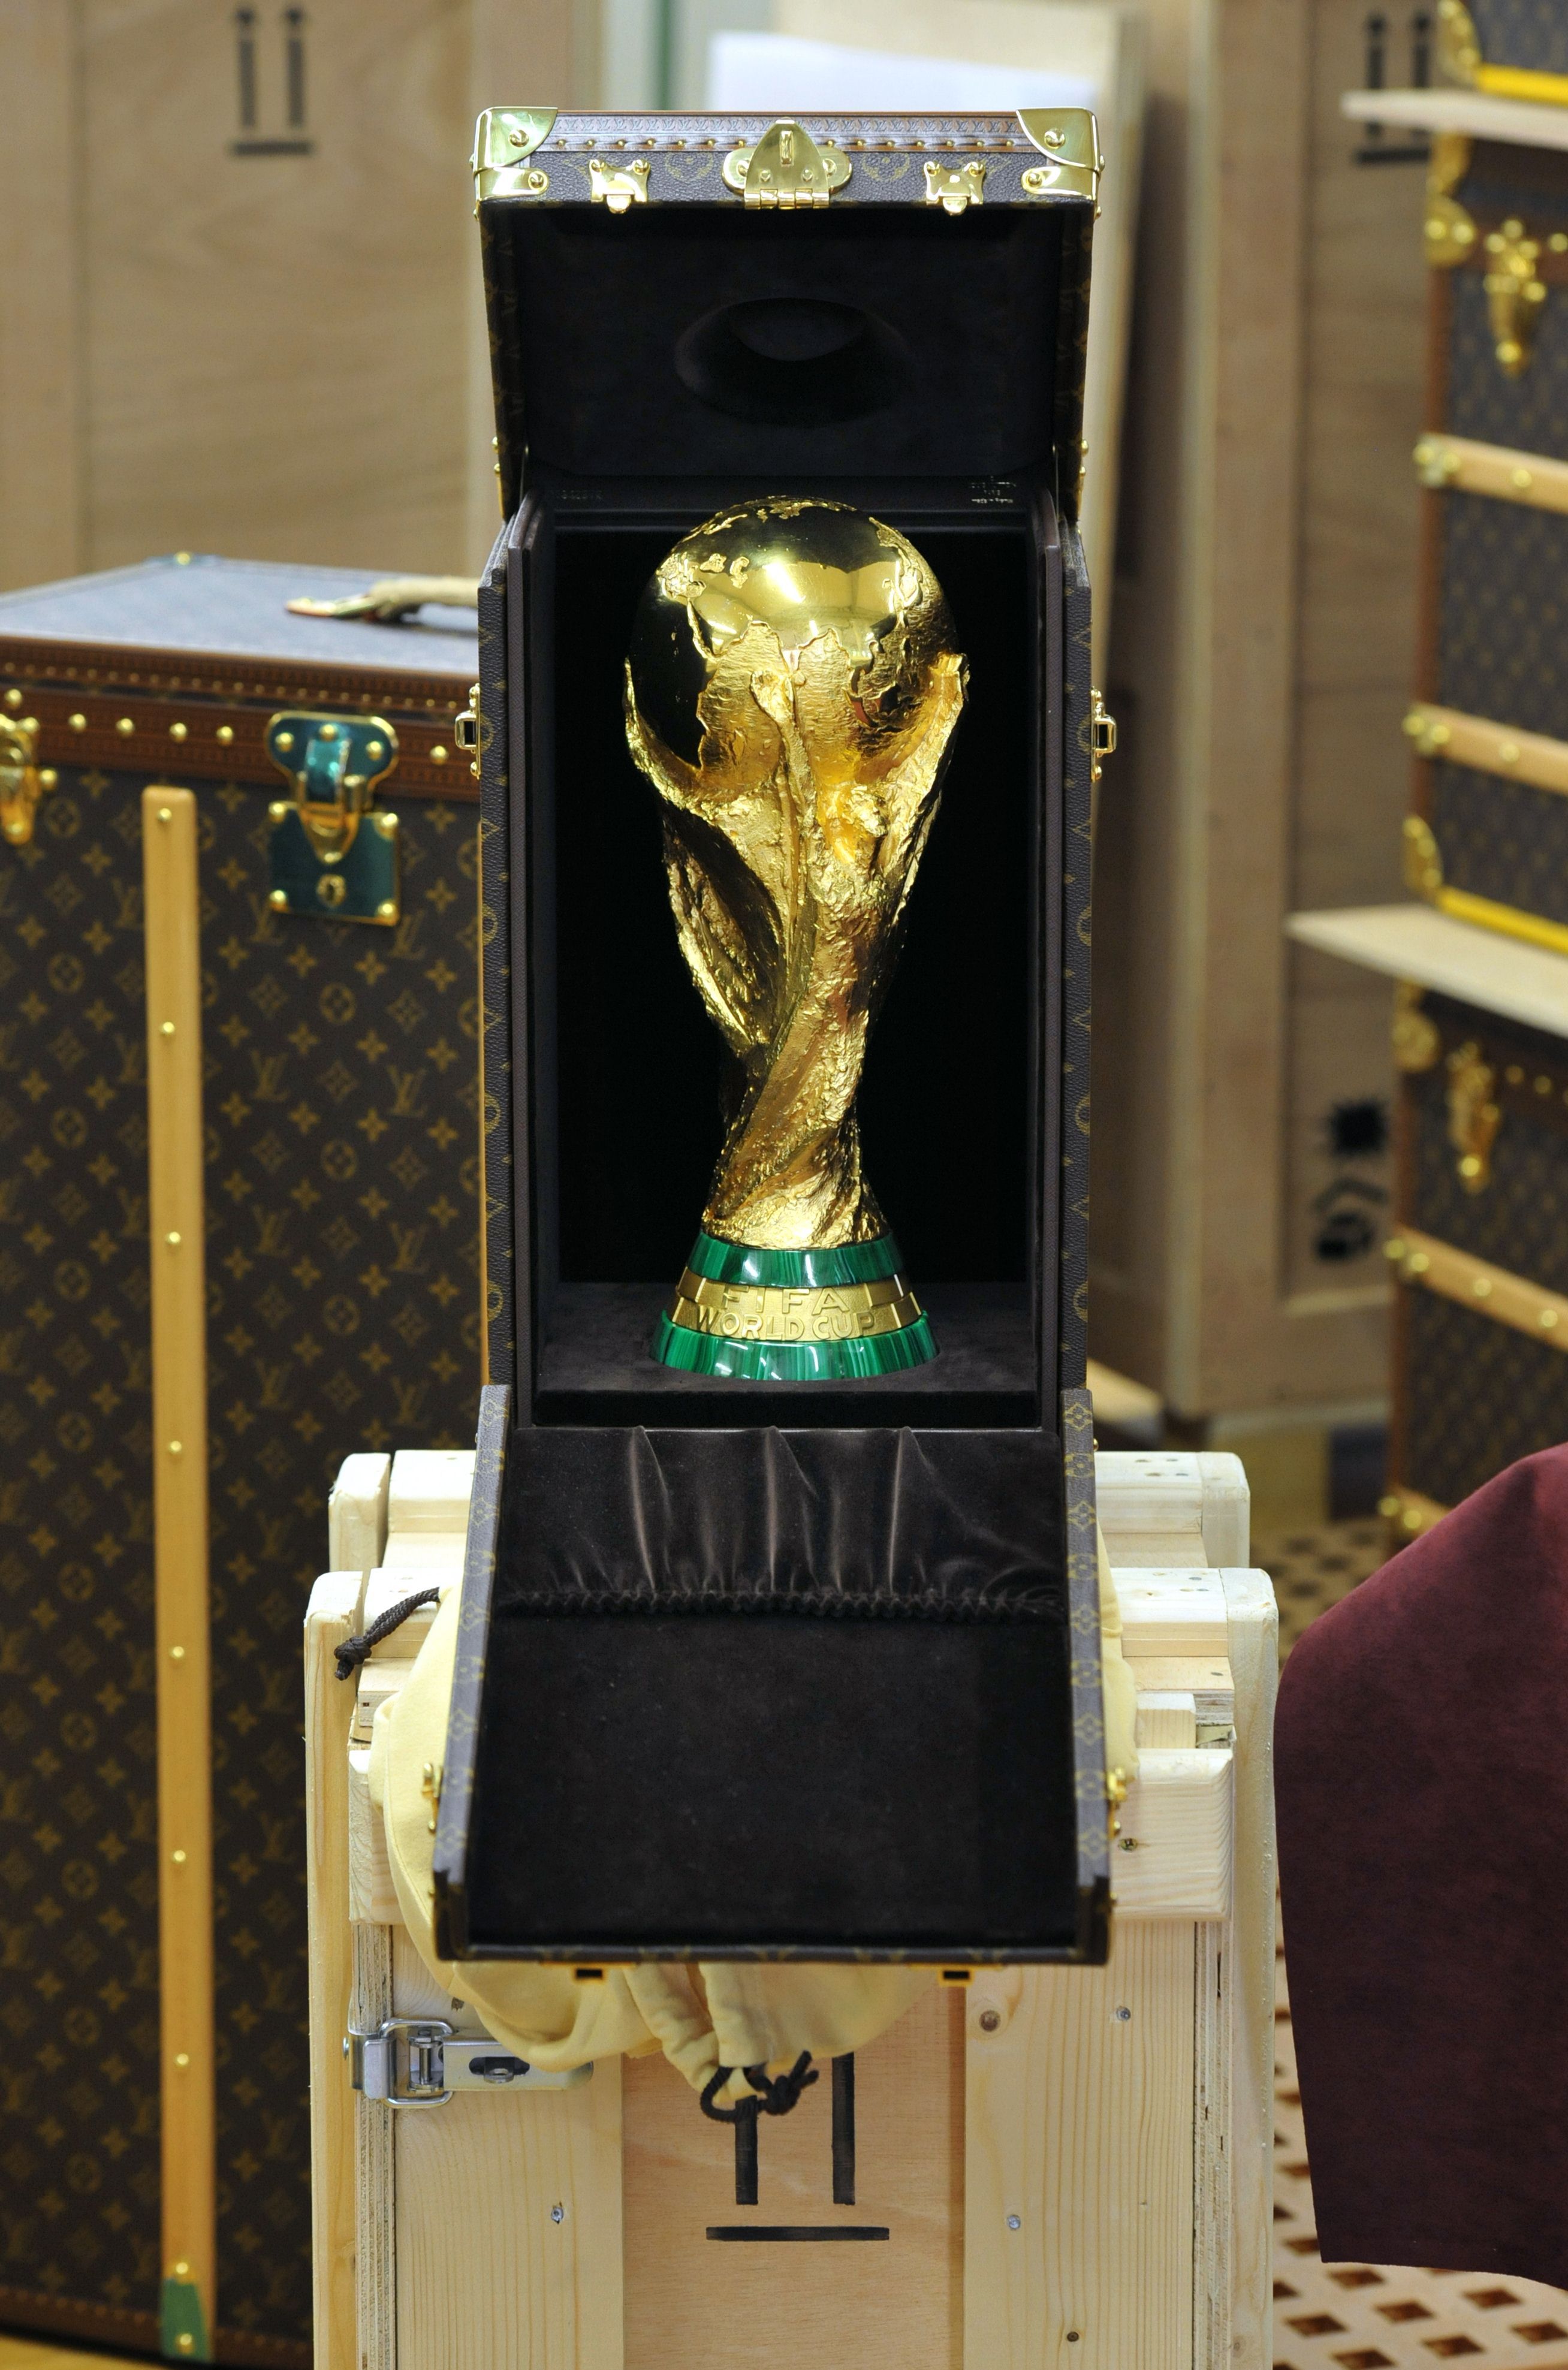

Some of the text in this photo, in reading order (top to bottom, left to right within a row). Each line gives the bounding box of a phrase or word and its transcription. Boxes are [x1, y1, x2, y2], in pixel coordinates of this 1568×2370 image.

[723, 1285, 850, 1316] FIFA
[696, 1305, 875, 1341] WORLD CUP
